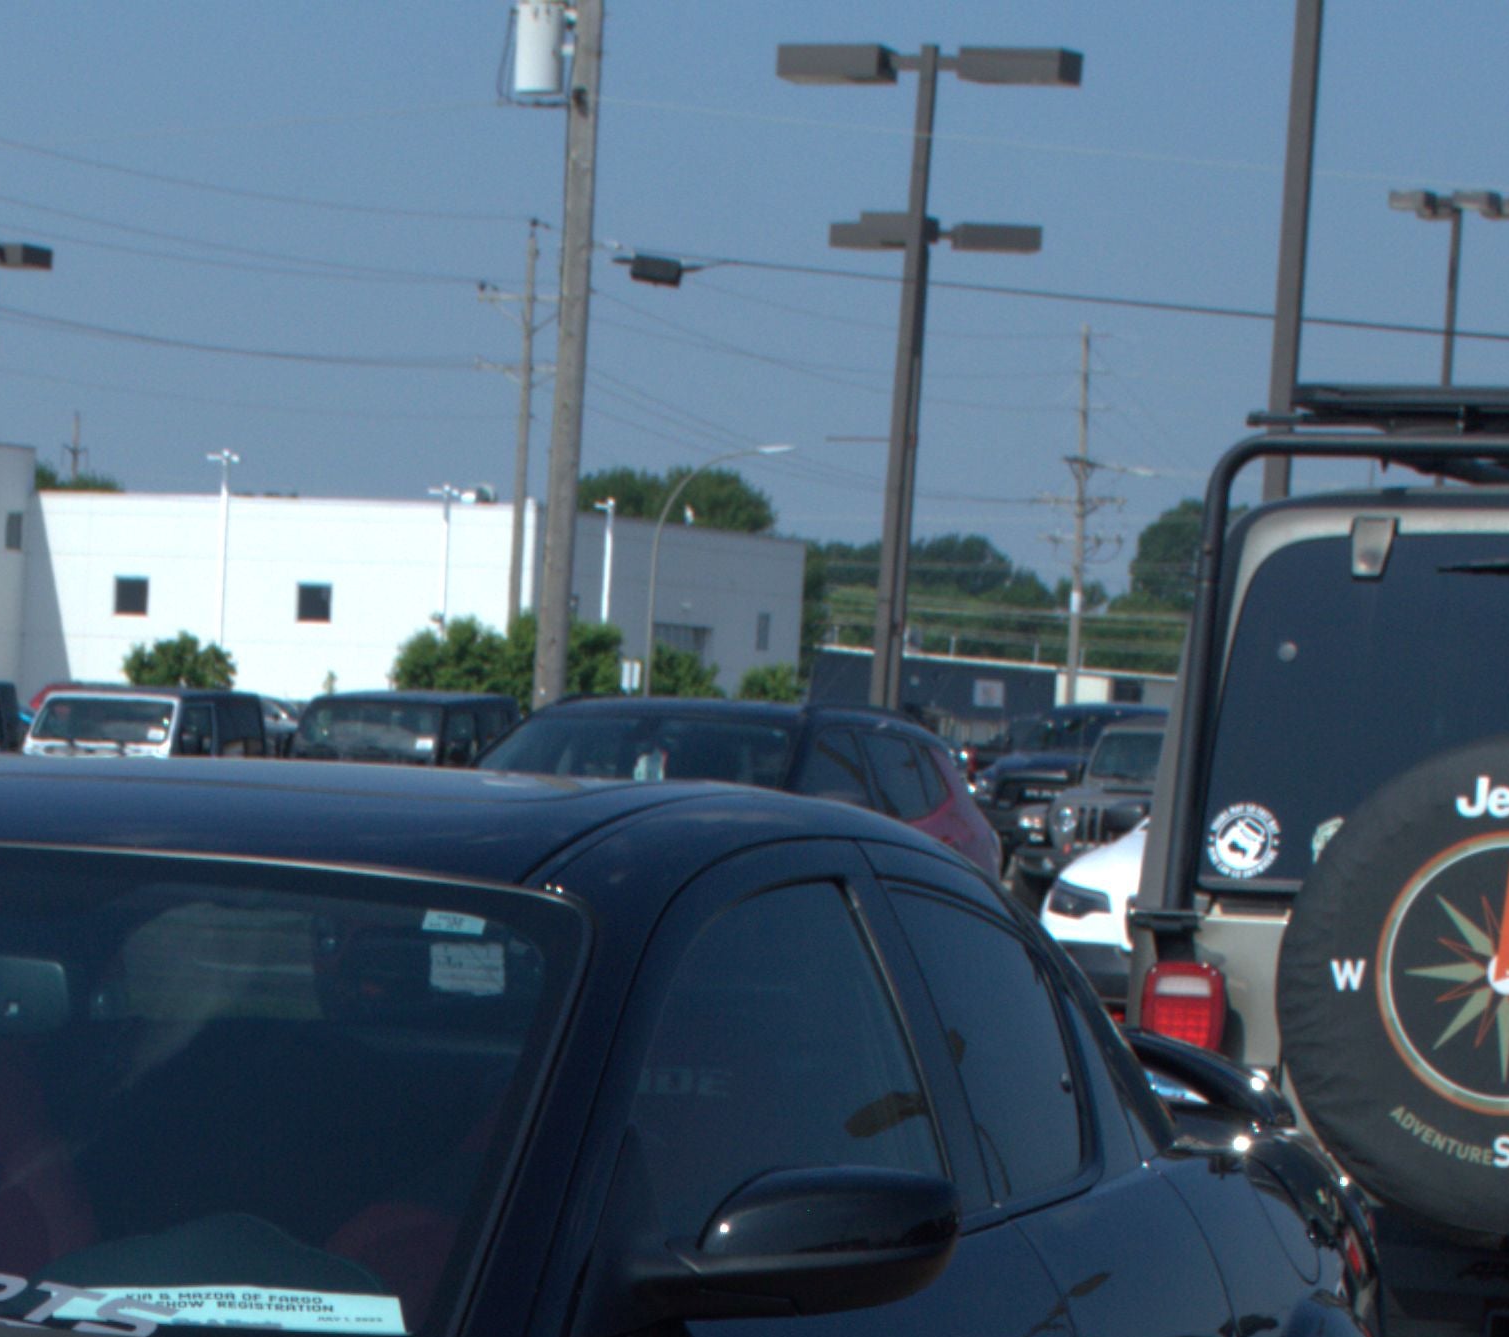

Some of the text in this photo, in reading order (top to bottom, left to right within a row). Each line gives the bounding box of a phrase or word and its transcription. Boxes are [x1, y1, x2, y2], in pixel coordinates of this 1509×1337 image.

[1330, 958, 1366, 992] W
[241, 1293, 262, 1301] OF
[216, 1299, 335, 1314] REGISTRATION
